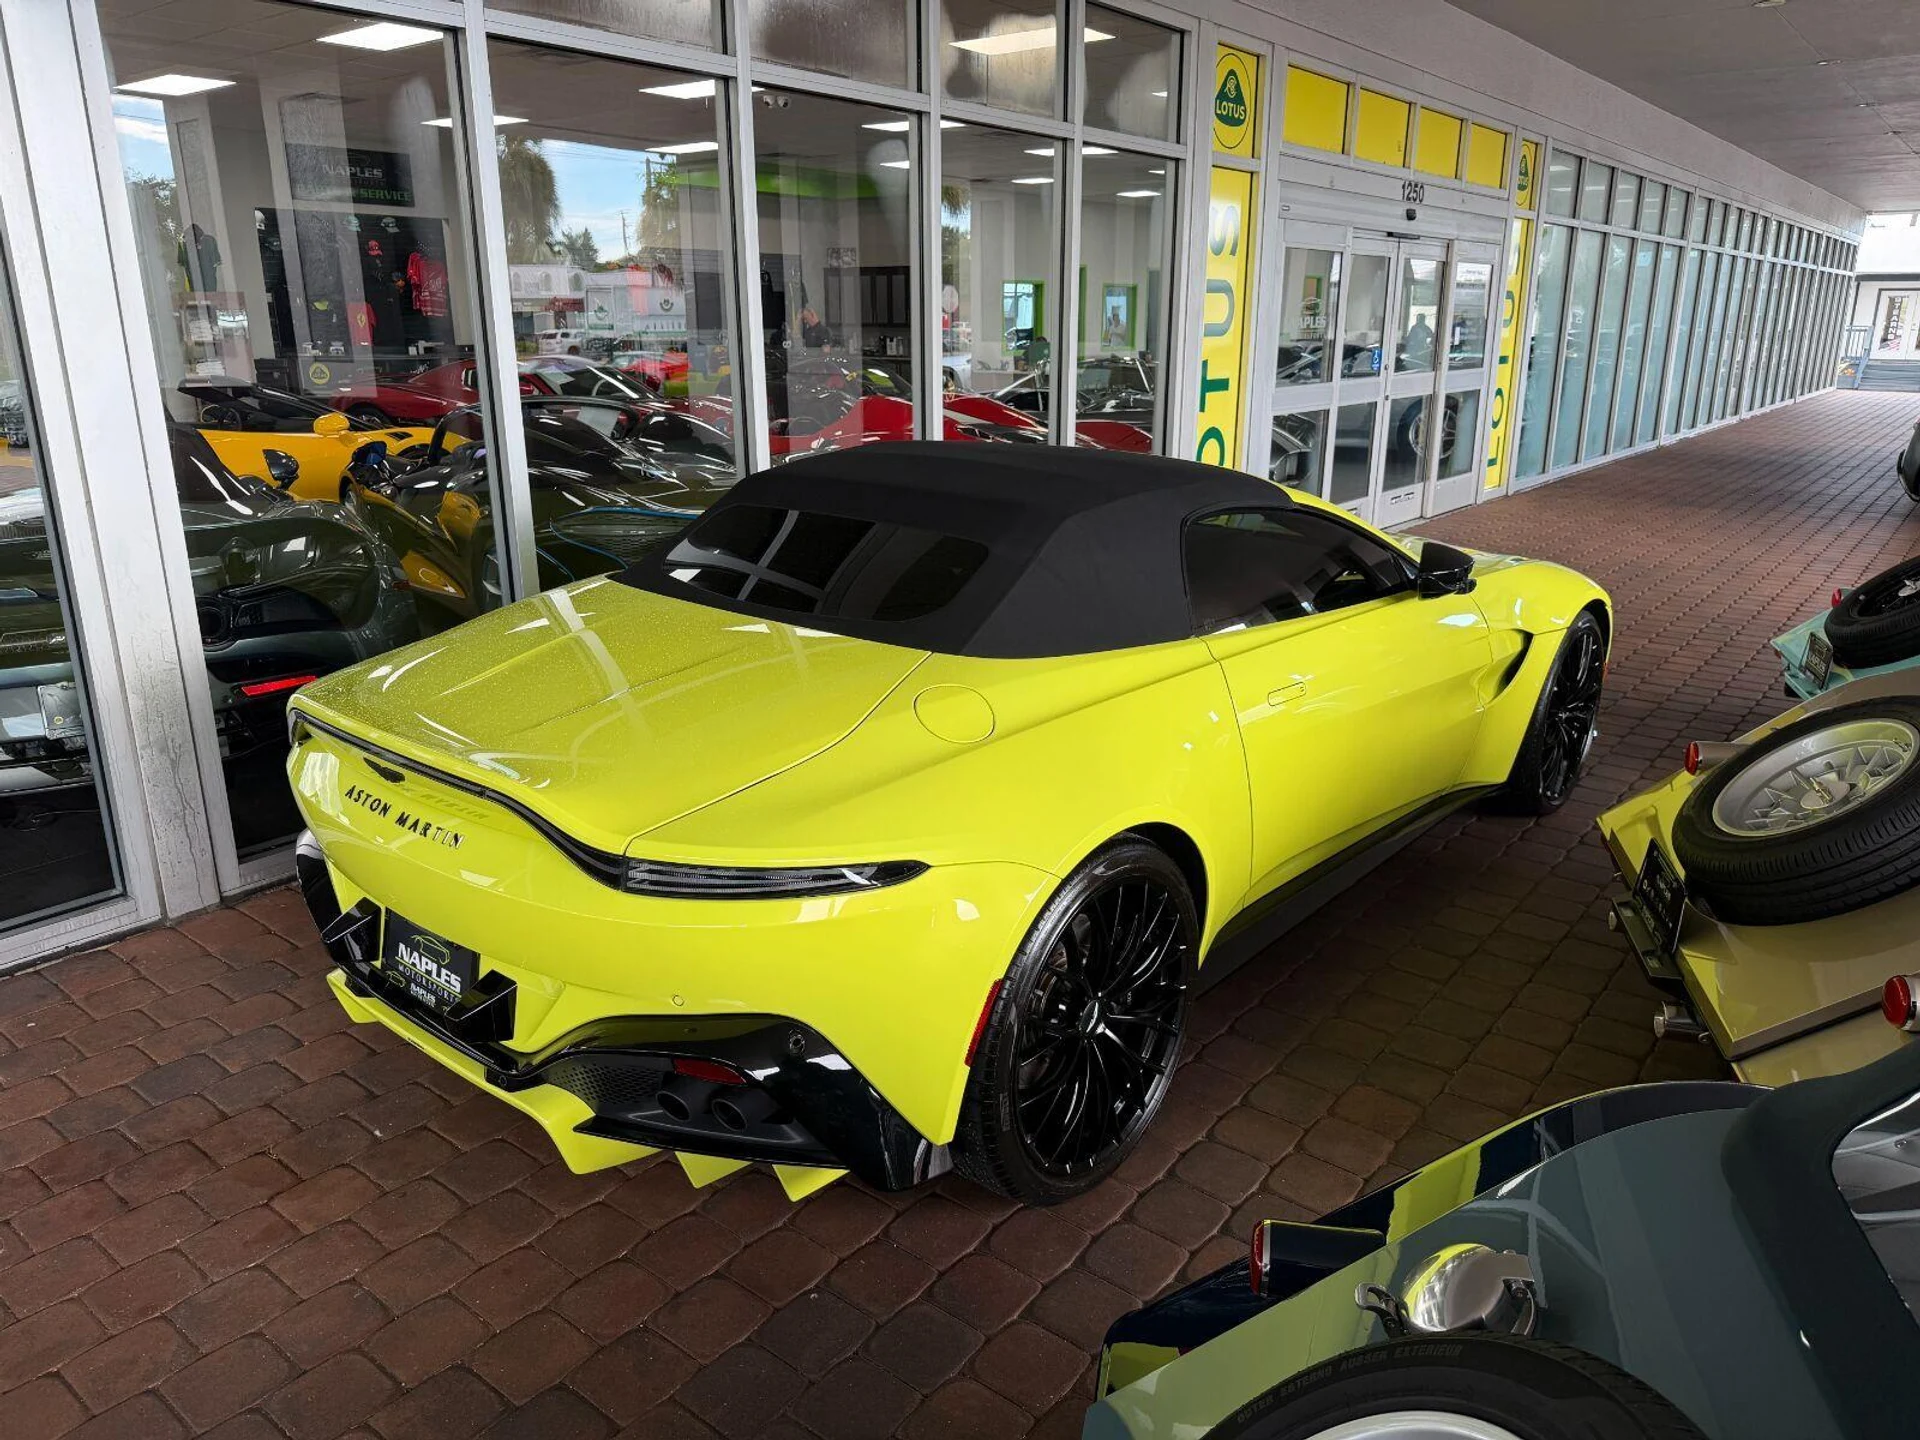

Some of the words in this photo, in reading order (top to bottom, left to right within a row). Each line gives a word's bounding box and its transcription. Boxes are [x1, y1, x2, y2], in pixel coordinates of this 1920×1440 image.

[1216, 100, 1246, 119] LOTUS
[322, 164, 382, 178] NAPLES
[360, 188, 412, 201] SERVICE
[1402, 181, 1424, 203] 1250
[1196, 205, 1240, 467] OTUS
[345, 784, 392, 818] ASTON
[395, 811, 464, 850] MARTIN
[398, 941, 461, 993] NAPLES
[1394, 1343, 1463, 1360] EXTERIEUR
